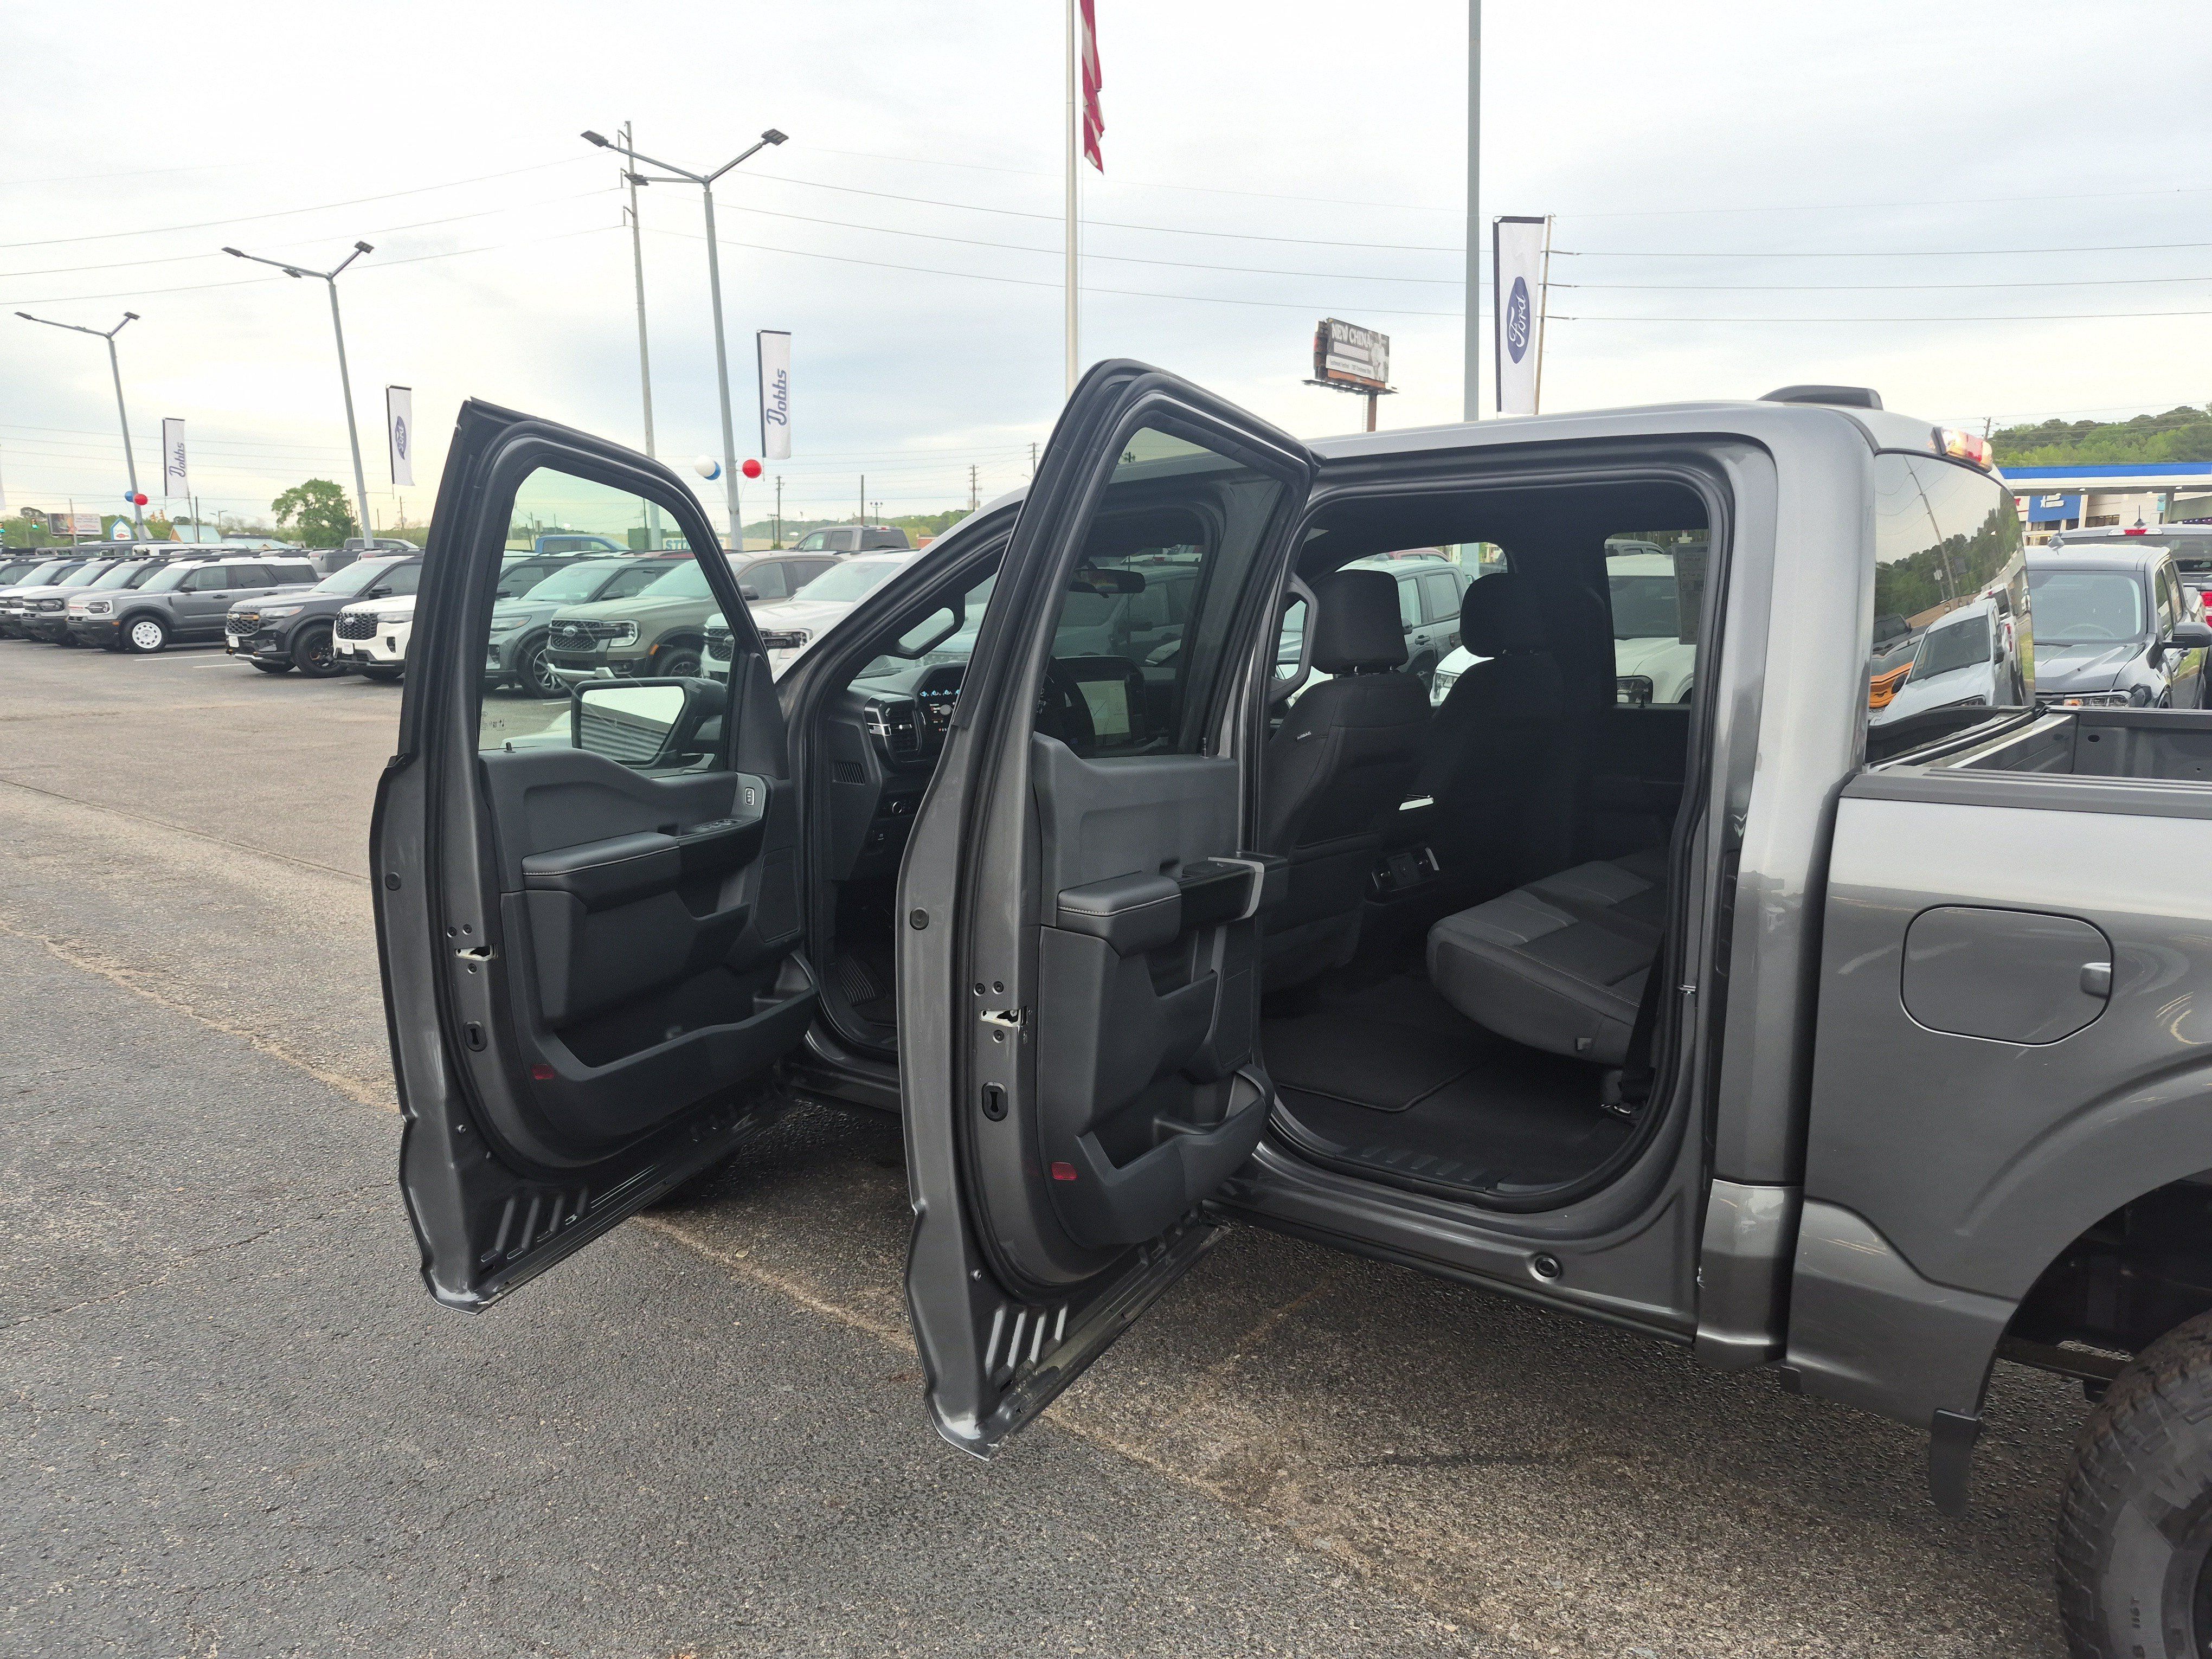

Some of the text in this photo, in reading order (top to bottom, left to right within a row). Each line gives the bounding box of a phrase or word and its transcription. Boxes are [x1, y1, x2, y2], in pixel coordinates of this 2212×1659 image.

[1332, 323, 1372, 349] NEW CHINA
[1509, 294, 1526, 348] Ford
[767, 368, 787, 426] Dobbs
[169, 442, 186, 477] Dobbs
